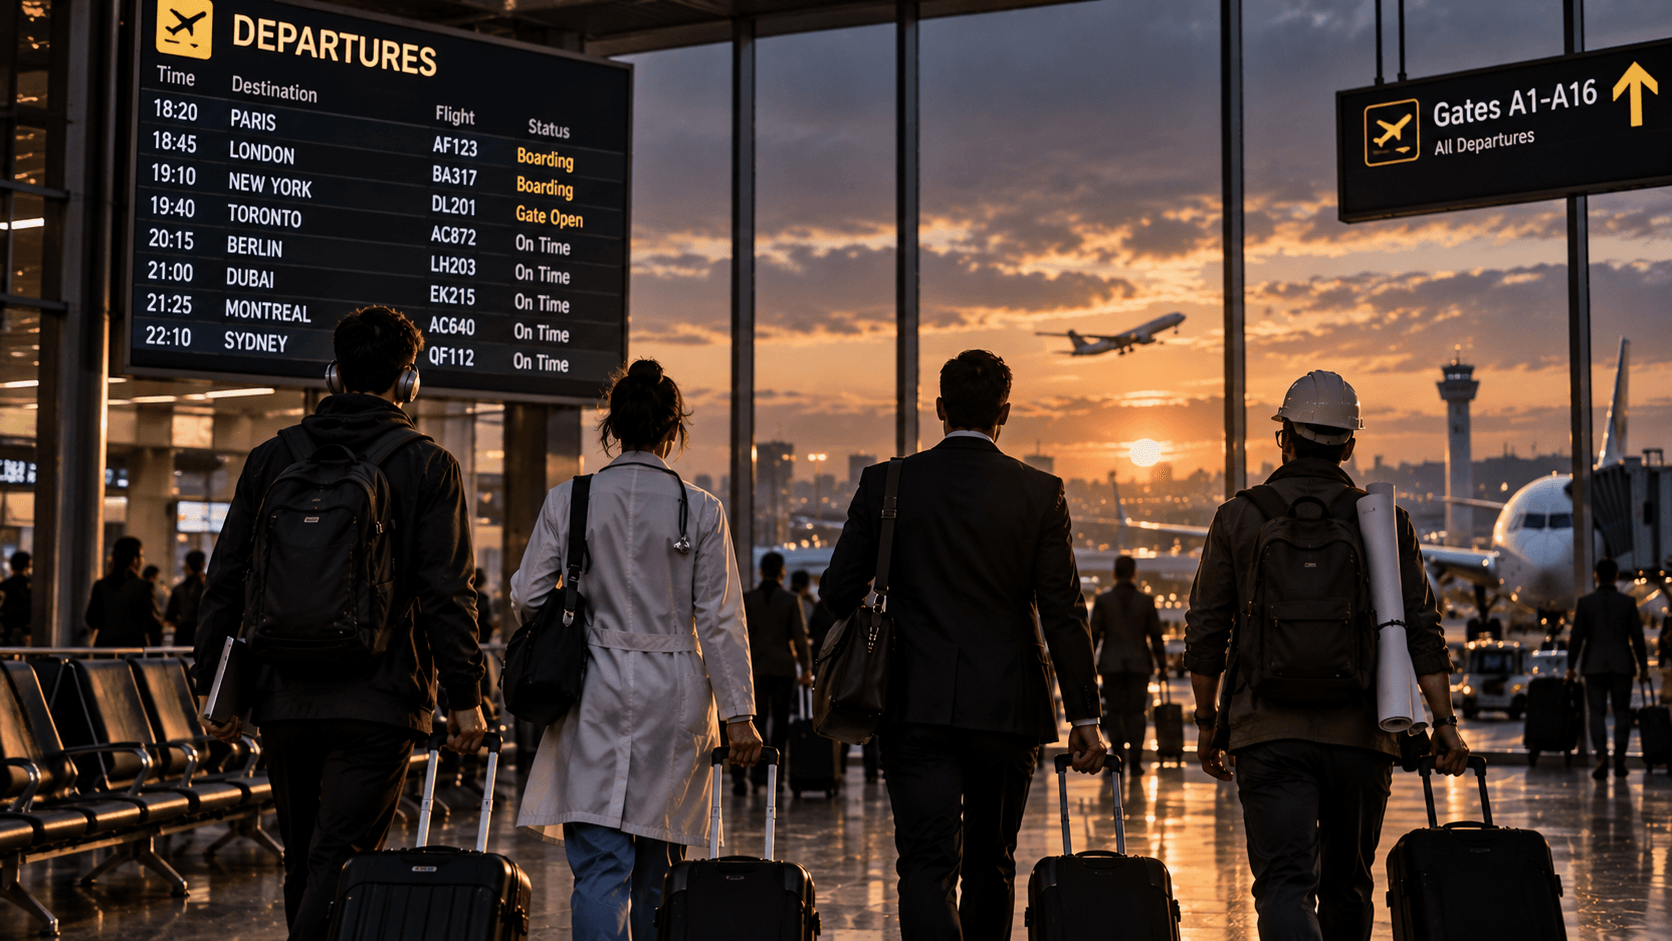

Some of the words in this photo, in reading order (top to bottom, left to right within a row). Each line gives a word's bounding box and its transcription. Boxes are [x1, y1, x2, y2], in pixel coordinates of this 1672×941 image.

[233, 14, 436, 77] DEPARTURES
[157, 65, 195, 86] Time
[233, 75, 317, 103] Destination
[437, 105, 474, 126] Flight
[529, 119, 569, 138] Status
[1434, 99, 1500, 127] Gates
[154, 99, 197, 121] 18:20
[231, 109, 276, 131] PARIS
[433, 136, 477, 157] AF123
[518, 147, 573, 173] Boarding
[1435, 139, 1452, 155] All
[1457, 131, 1534, 154] Departures
[153, 131, 196, 153] 18:45
[230, 141, 294, 165] LONDON
[433, 165, 477, 186] BA317
[517, 176, 573, 201] Boarding
[152, 163, 196, 185] 19:10
[229, 172, 265, 192] NEW
[271, 177, 312, 198] YORK
[432, 195, 475, 215] DL201
[516, 205, 546, 223] Gate
[551, 209, 583, 229] Open
[151, 196, 195, 217] 19:40
[228, 204, 301, 228] TORONTO
[431, 225, 476, 245] AC872
[516, 234, 533, 251] On
[539, 237, 570, 255] Time
[149, 228, 193, 250] 20:15
[228, 236, 282, 257] BERLIN
[431, 255, 475, 275] LH203
[516, 264, 533, 280] On
[538, 266, 570, 284] Time
[148, 261, 193, 282] 21:00
[227, 267, 273, 288] DUBAI
[431, 285, 475, 305] EK215
[515, 293, 532, 310] On
[538, 295, 569, 313] Time
[147, 293, 192, 314] 21:25
[226, 299, 311, 323] MONTREAL
[429, 316, 475, 335] AC640
[514, 323, 532, 339] On
[537, 325, 569, 343] Time
[146, 326, 191, 346] 22:10
[225, 331, 288, 352] SYDNEY
[429, 346, 474, 366] QF112
[514, 352, 531, 369] On
[537, 354, 569, 372] Time
